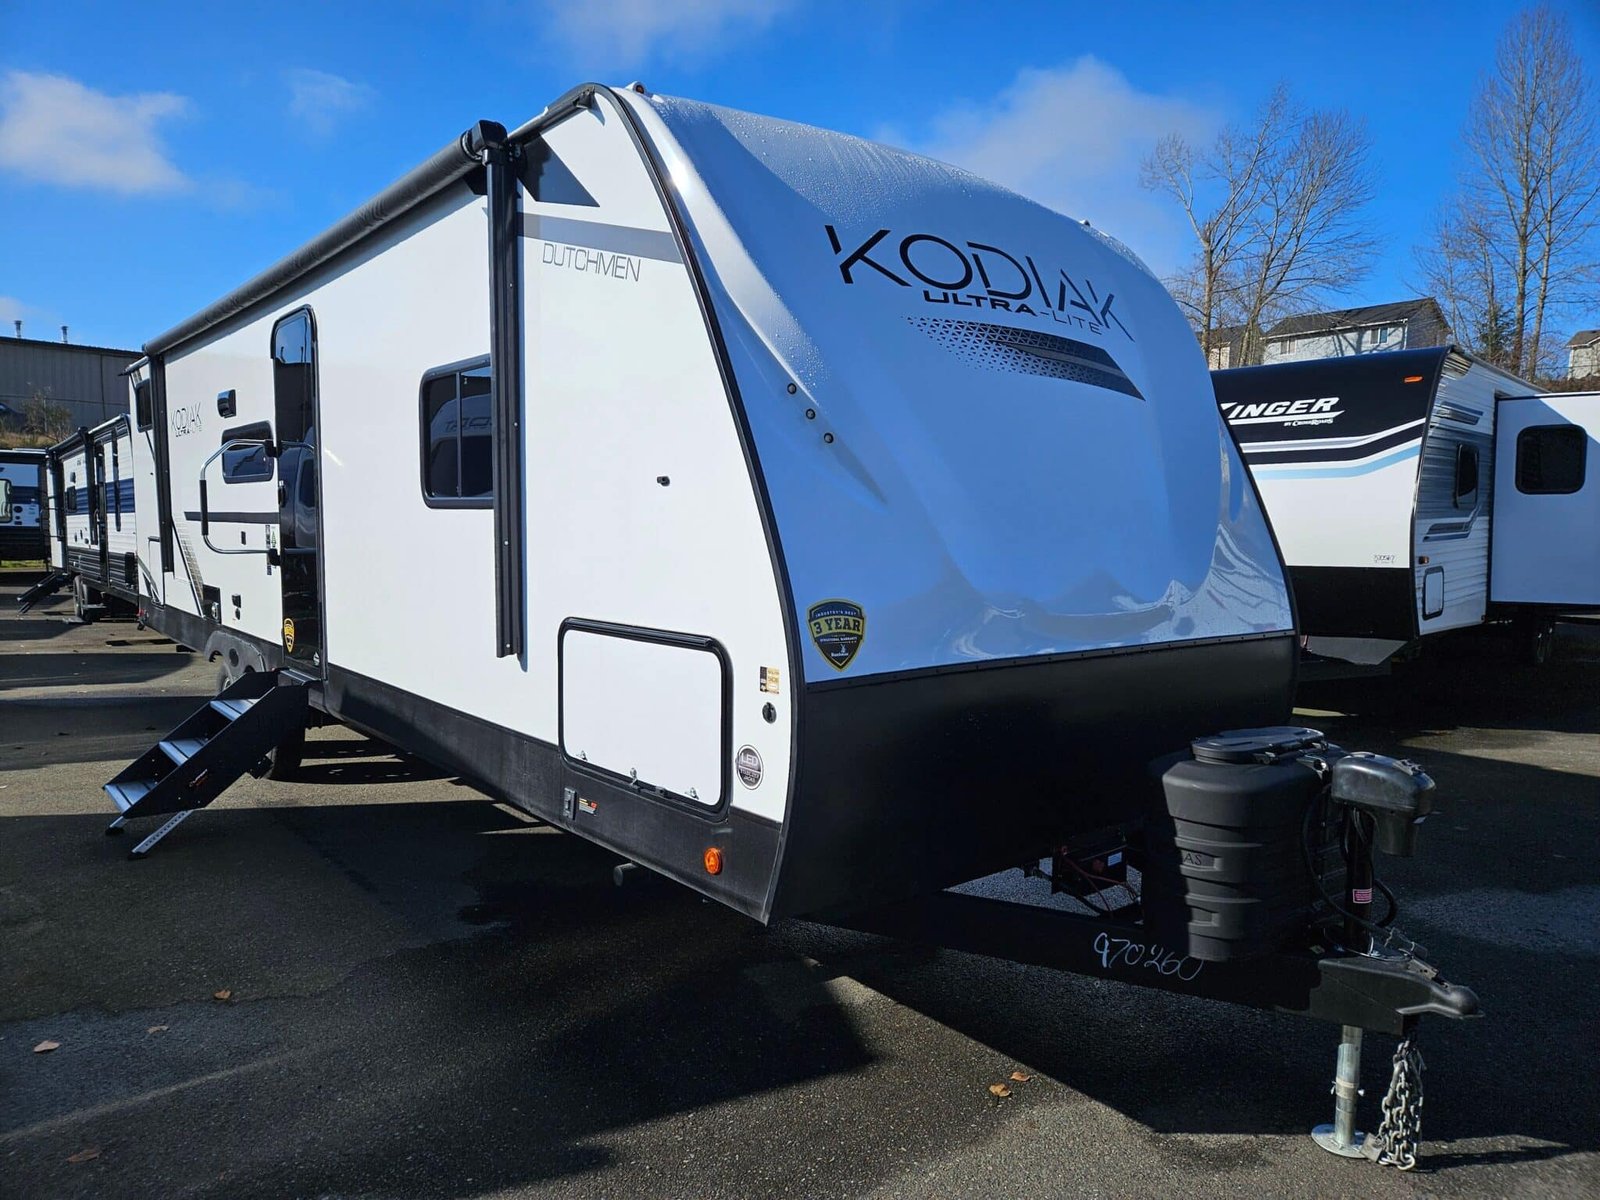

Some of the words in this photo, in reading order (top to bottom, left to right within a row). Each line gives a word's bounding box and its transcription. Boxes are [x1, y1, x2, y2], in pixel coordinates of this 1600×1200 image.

[542, 242, 641, 282] DUTCHMEN
[825, 224, 1136, 343] KODIAK
[923, 289, 1103, 336] ULTRA-LITE
[170, 401, 203, 431] KODIAK
[813, 621, 822, 634] 3
[824, 617, 861, 632] YEAR
[740, 753, 759, 766] LED
[1094, 932, 1204, 980] 970260
